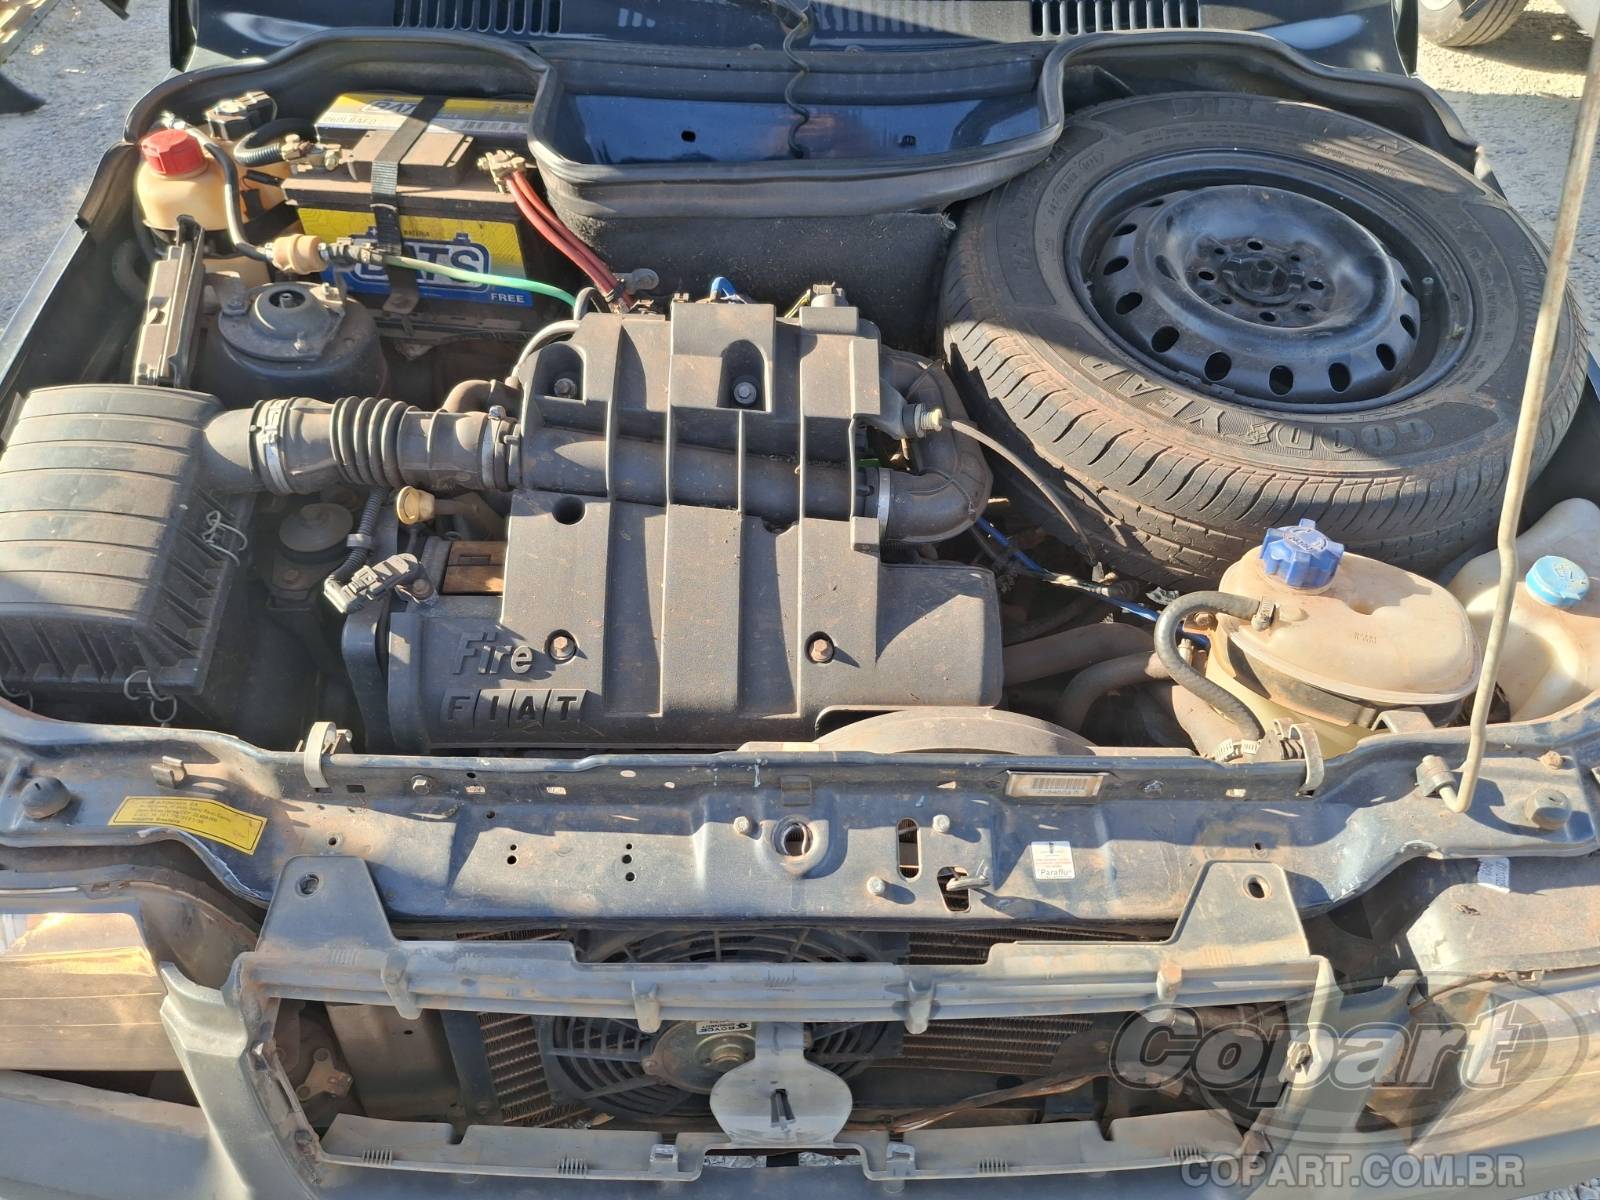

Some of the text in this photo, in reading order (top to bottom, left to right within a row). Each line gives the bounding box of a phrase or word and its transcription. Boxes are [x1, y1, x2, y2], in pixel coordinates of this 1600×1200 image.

[490, 292, 526, 304] FREE
[453, 631, 533, 675] Fire
[446, 694, 578, 723] FIAT
